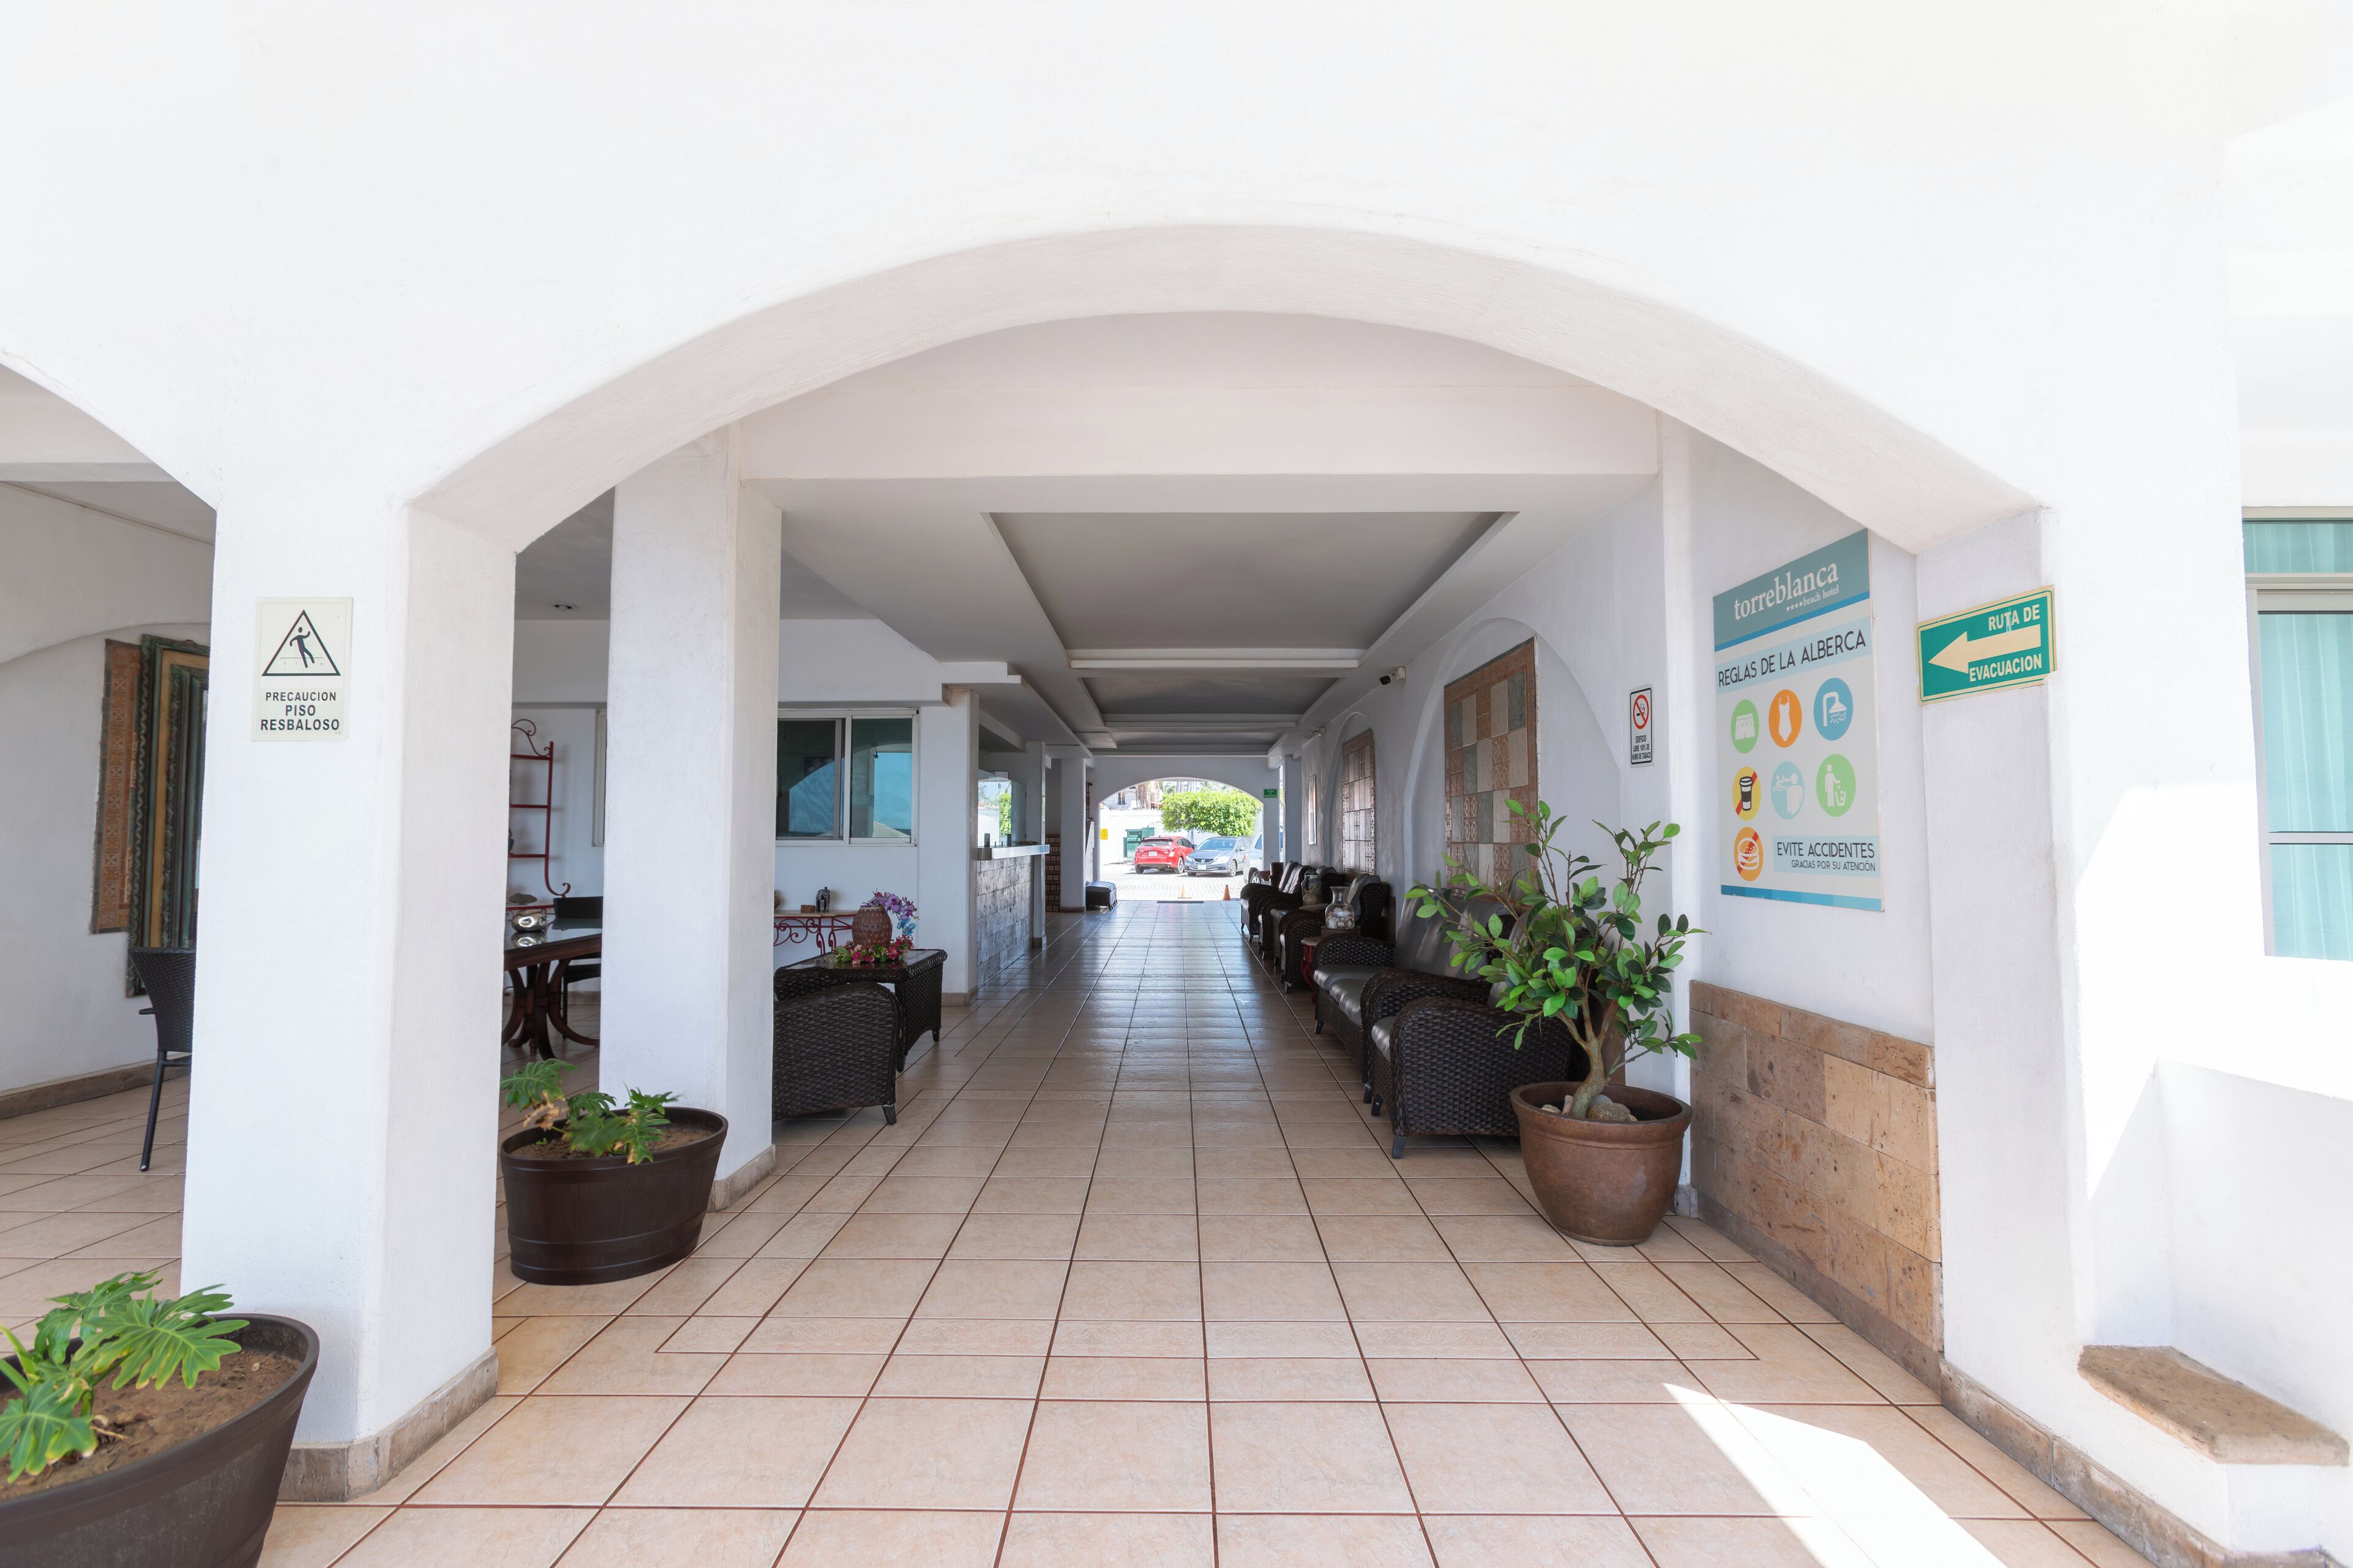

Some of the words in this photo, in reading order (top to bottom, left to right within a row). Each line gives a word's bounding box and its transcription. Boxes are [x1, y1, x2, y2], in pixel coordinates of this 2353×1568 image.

[1734, 563, 1839, 620] torreblanca
[1803, 592, 1821, 606] beach
[1822, 585, 1839, 599] hotel
[1988, 610, 2020, 631] RUTA
[2023, 604, 2040, 623] DE
[1718, 661, 1757, 687] REGLAS
[1761, 654, 1776, 675] DE
[1779, 650, 1795, 670] LA
[1801, 629, 1866, 664] ALBERCA
[1969, 654, 2042, 682] EVACUACION
[265, 692, 336, 702] PRECAUCION
[285, 705, 316, 716] PISO
[260, 719, 339, 730] RESBALOSO
[1777, 842, 1804, 856] EVITE
[1808, 842, 1874, 858] ACCIDENTES
[1792, 860, 1815, 868] GRACIAS
[1817, 861, 1830, 869] POR
[1832, 862, 1841, 870] SU
[1843, 860, 1876, 871] ATENCIÓN
